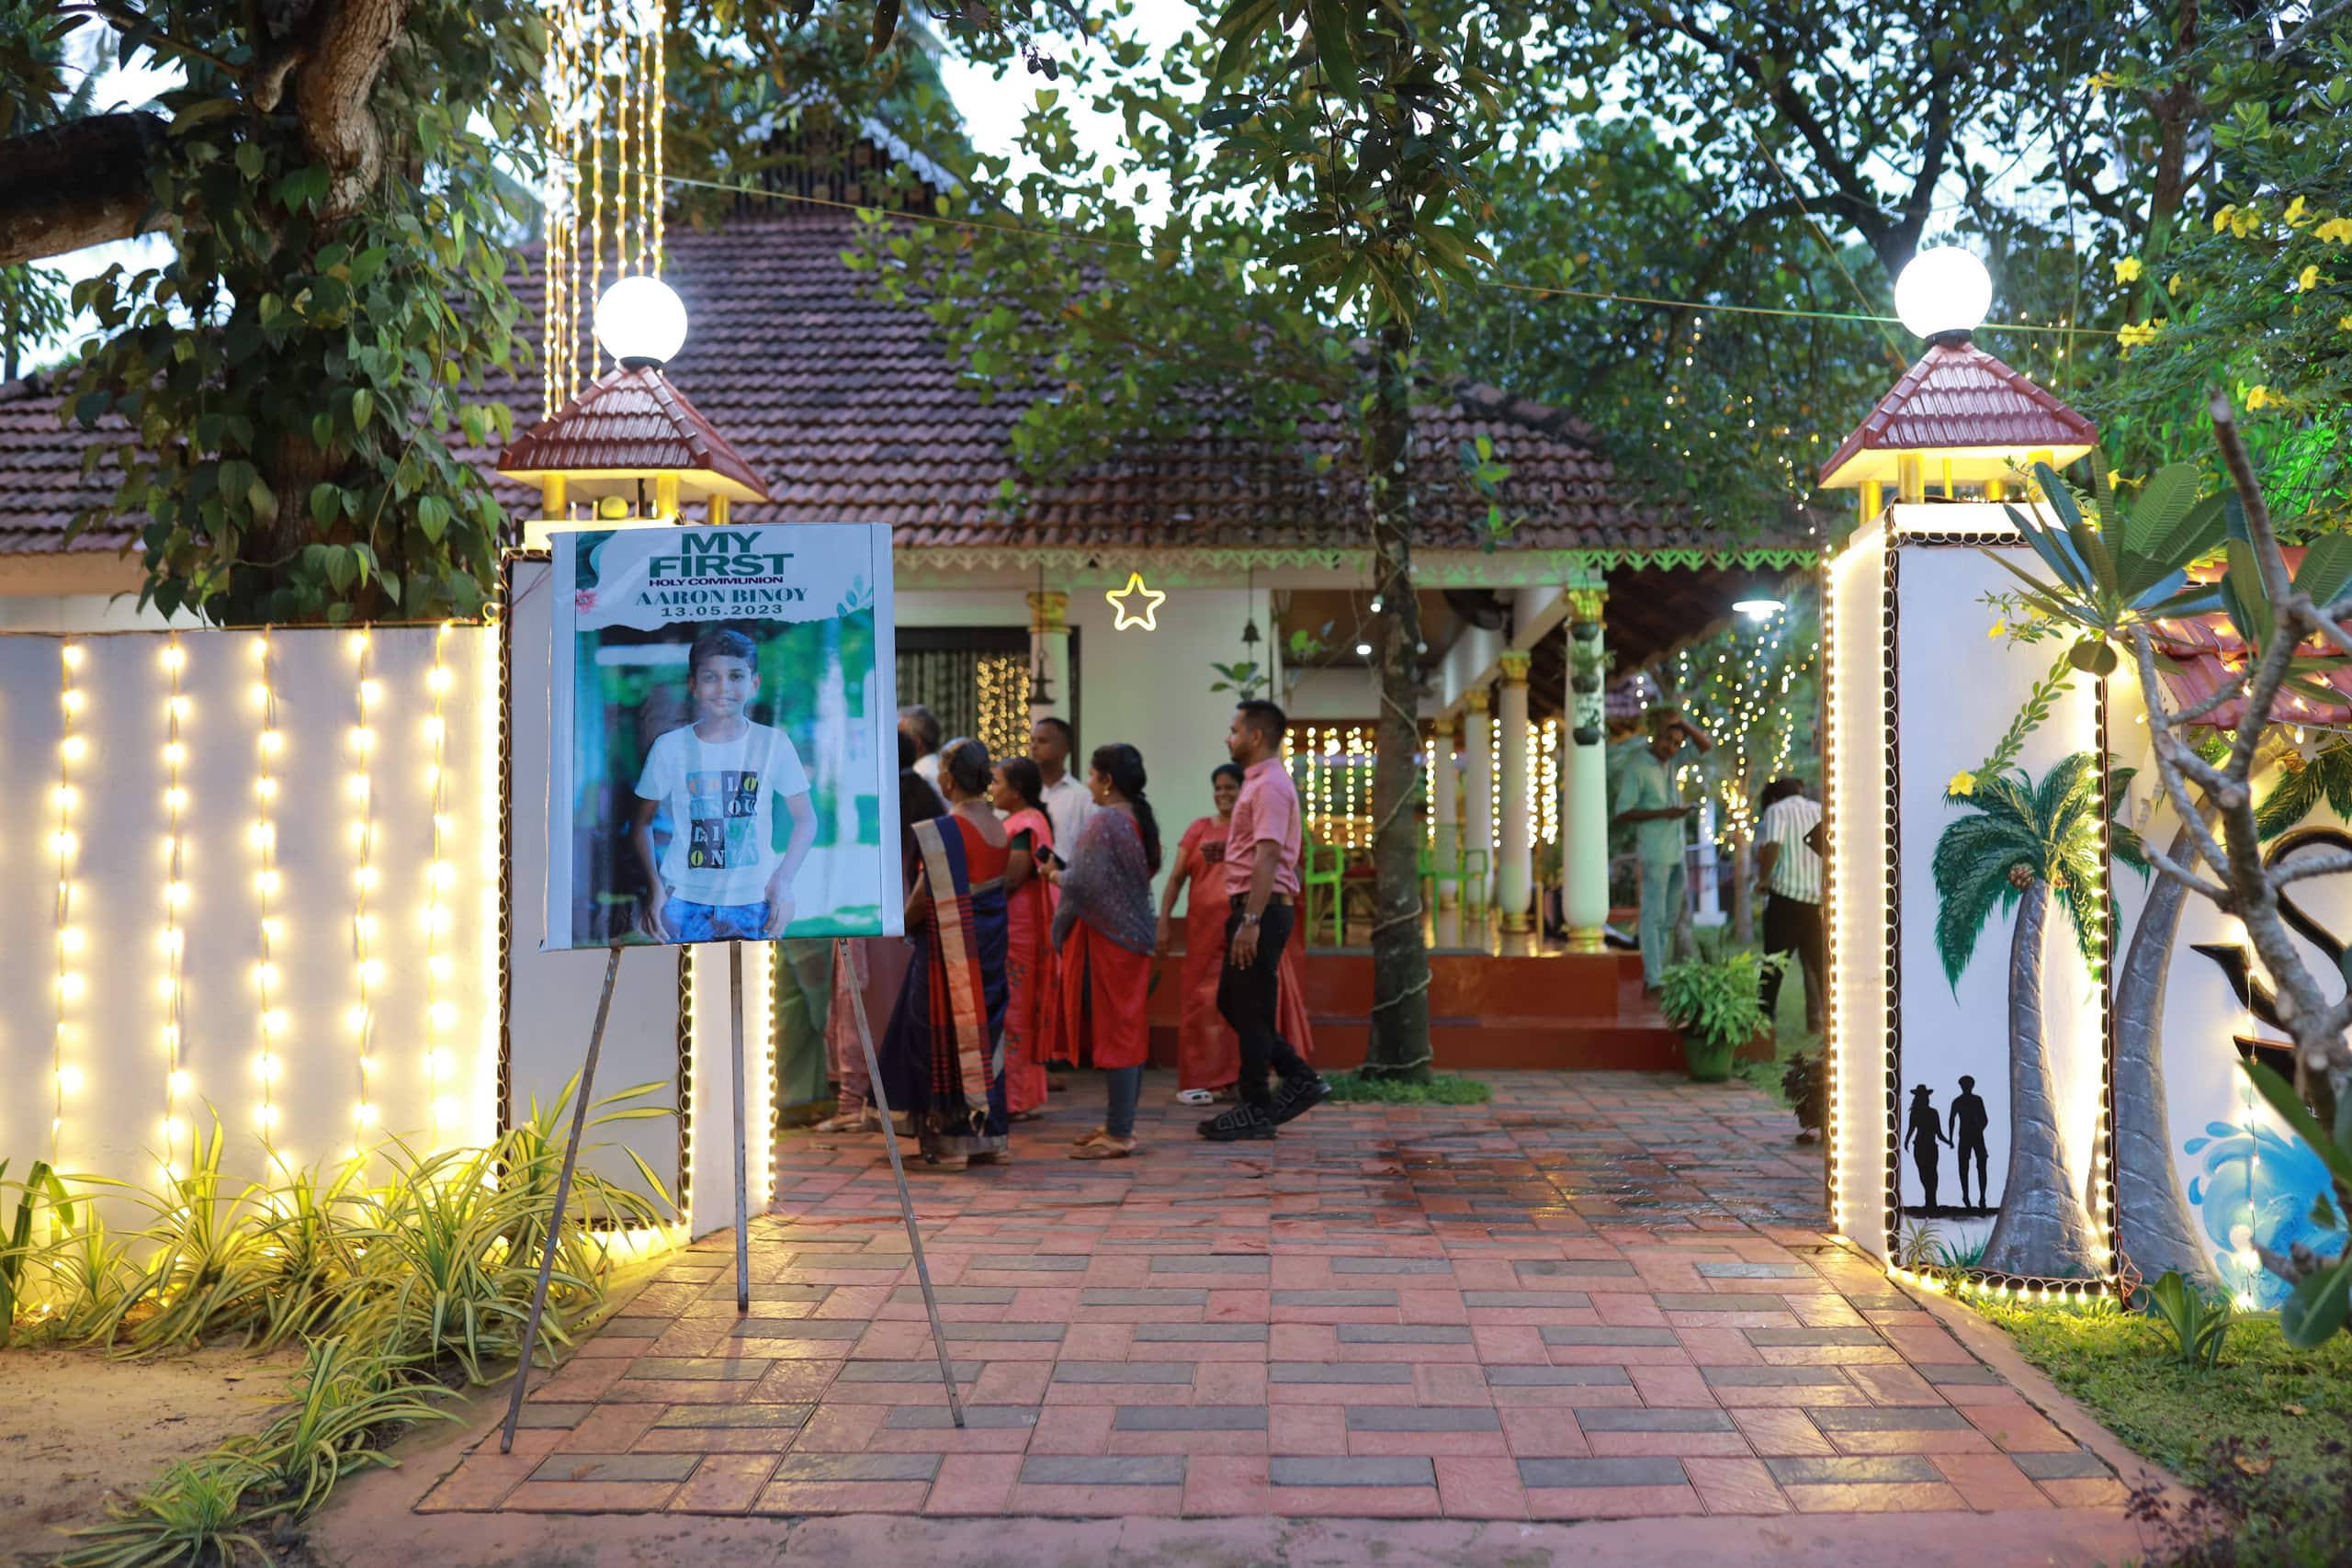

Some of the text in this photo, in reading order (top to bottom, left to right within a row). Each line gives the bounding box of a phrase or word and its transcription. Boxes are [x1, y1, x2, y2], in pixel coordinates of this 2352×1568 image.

[682, 531, 763, 554] MY
[650, 553, 794, 578] FIRST
[650, 576, 784, 587] HOLY COMMUNION
[636, 587, 808, 605] AARON BINOY
[662, 604, 783, 617] 13.05.2023
